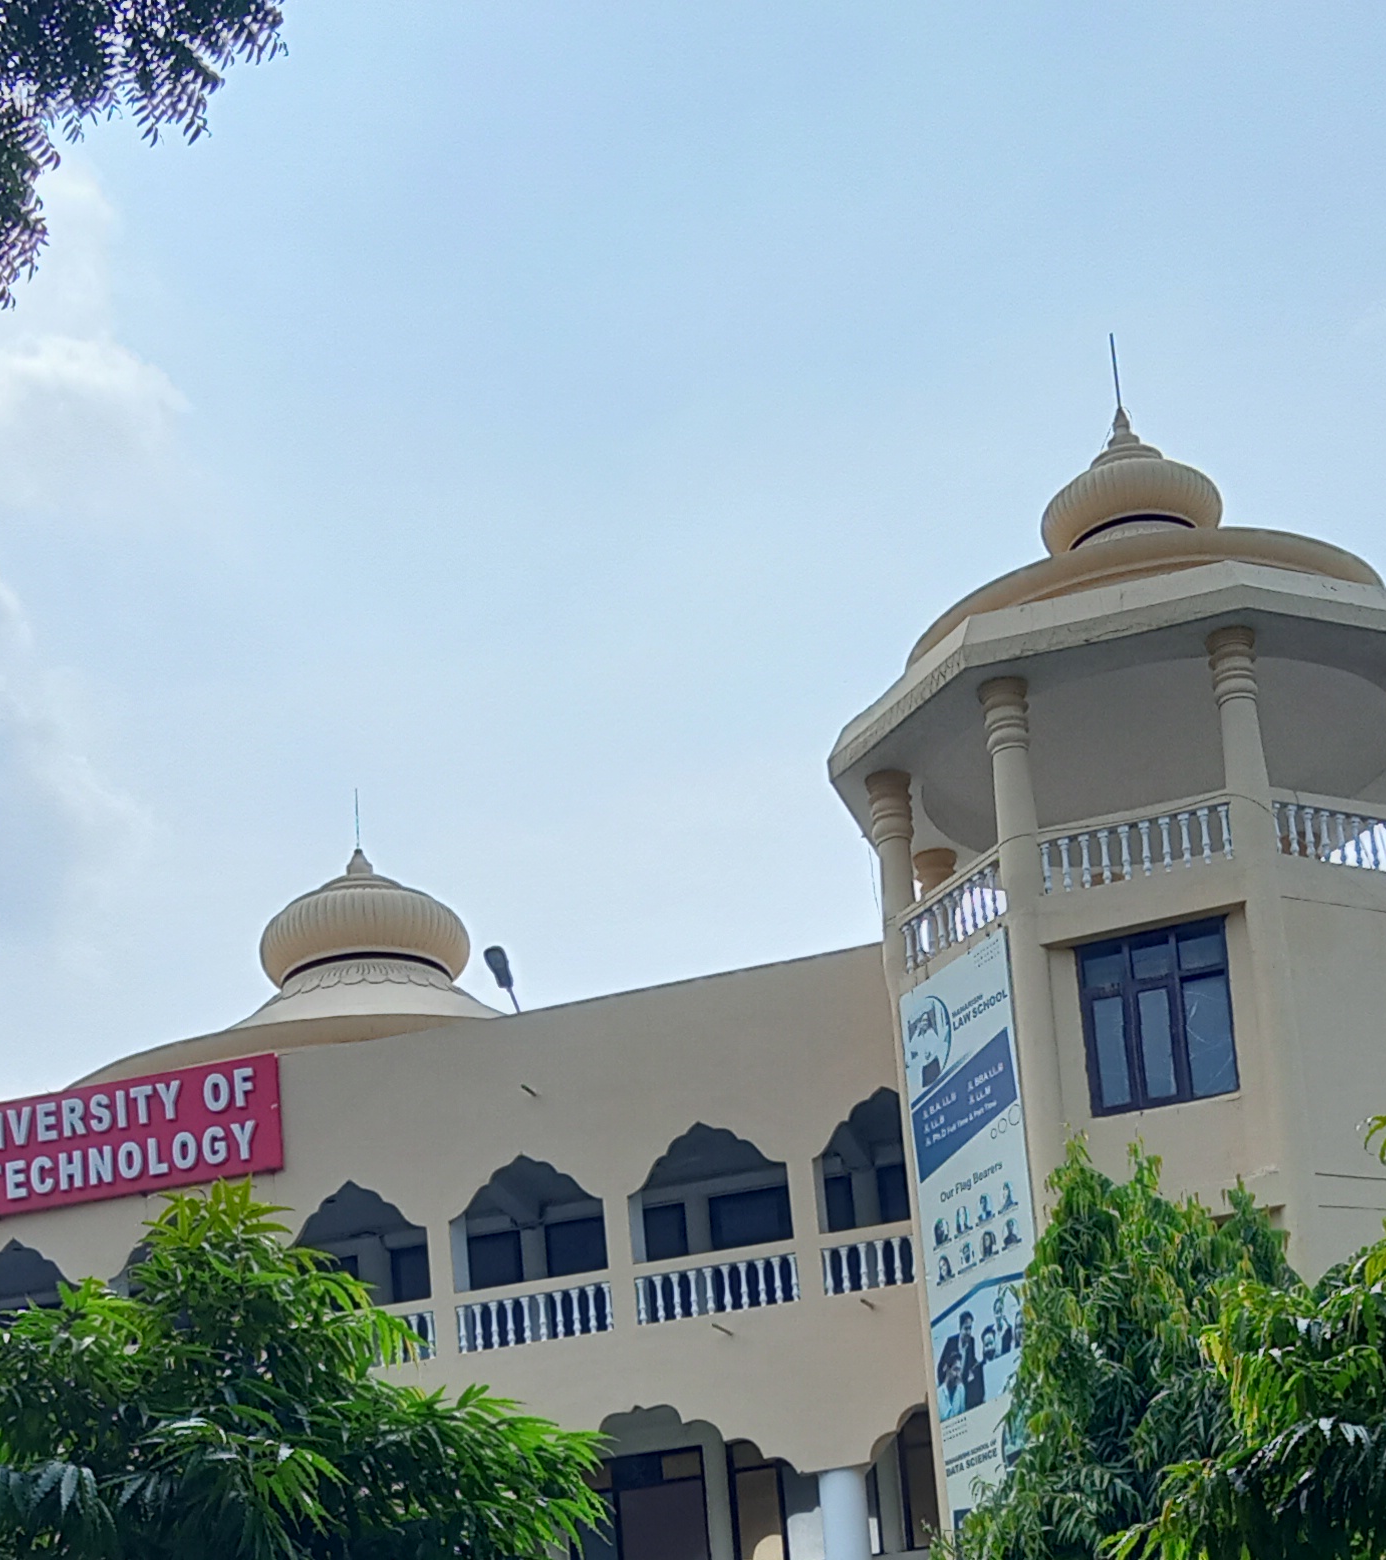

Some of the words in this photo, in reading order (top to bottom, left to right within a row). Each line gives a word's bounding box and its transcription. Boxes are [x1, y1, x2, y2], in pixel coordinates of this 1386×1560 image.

[953, 1011, 971, 1031] LAW
[972, 990, 1008, 1019] SCHOOL
[203, 1066, 255, 1113] OF
[940, 1187, 955, 1203] Our
[956, 1179, 971, 1195] Flag
[972, 1161, 1003, 1185] Bearers
[946, 1462, 964, 1478] DATA
[966, 1447, 998, 1469] SCIENCE
